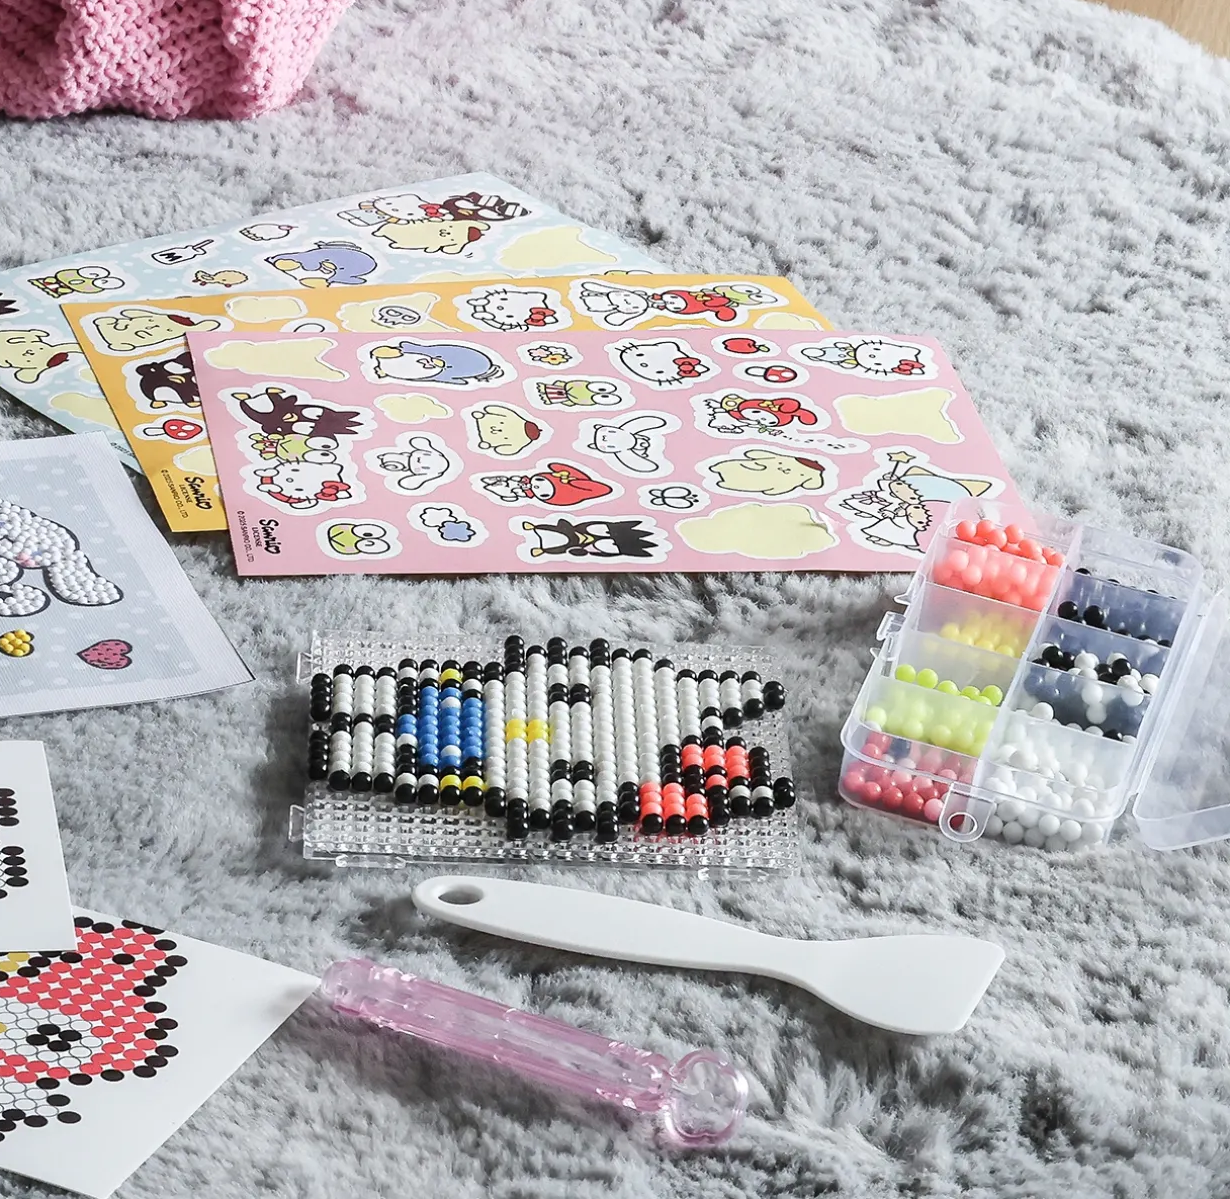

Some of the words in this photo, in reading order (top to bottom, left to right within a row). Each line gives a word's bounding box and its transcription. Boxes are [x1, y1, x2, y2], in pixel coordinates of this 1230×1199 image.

[158, 252, 183, 262] M
[178, 484, 193, 504] LICENSE
[184, 476, 213, 510] Sanrio
[240, 525, 251, 544] SANRIO
[251, 526, 262, 548] LICENSE
[259, 519, 282, 554] Sanrio
